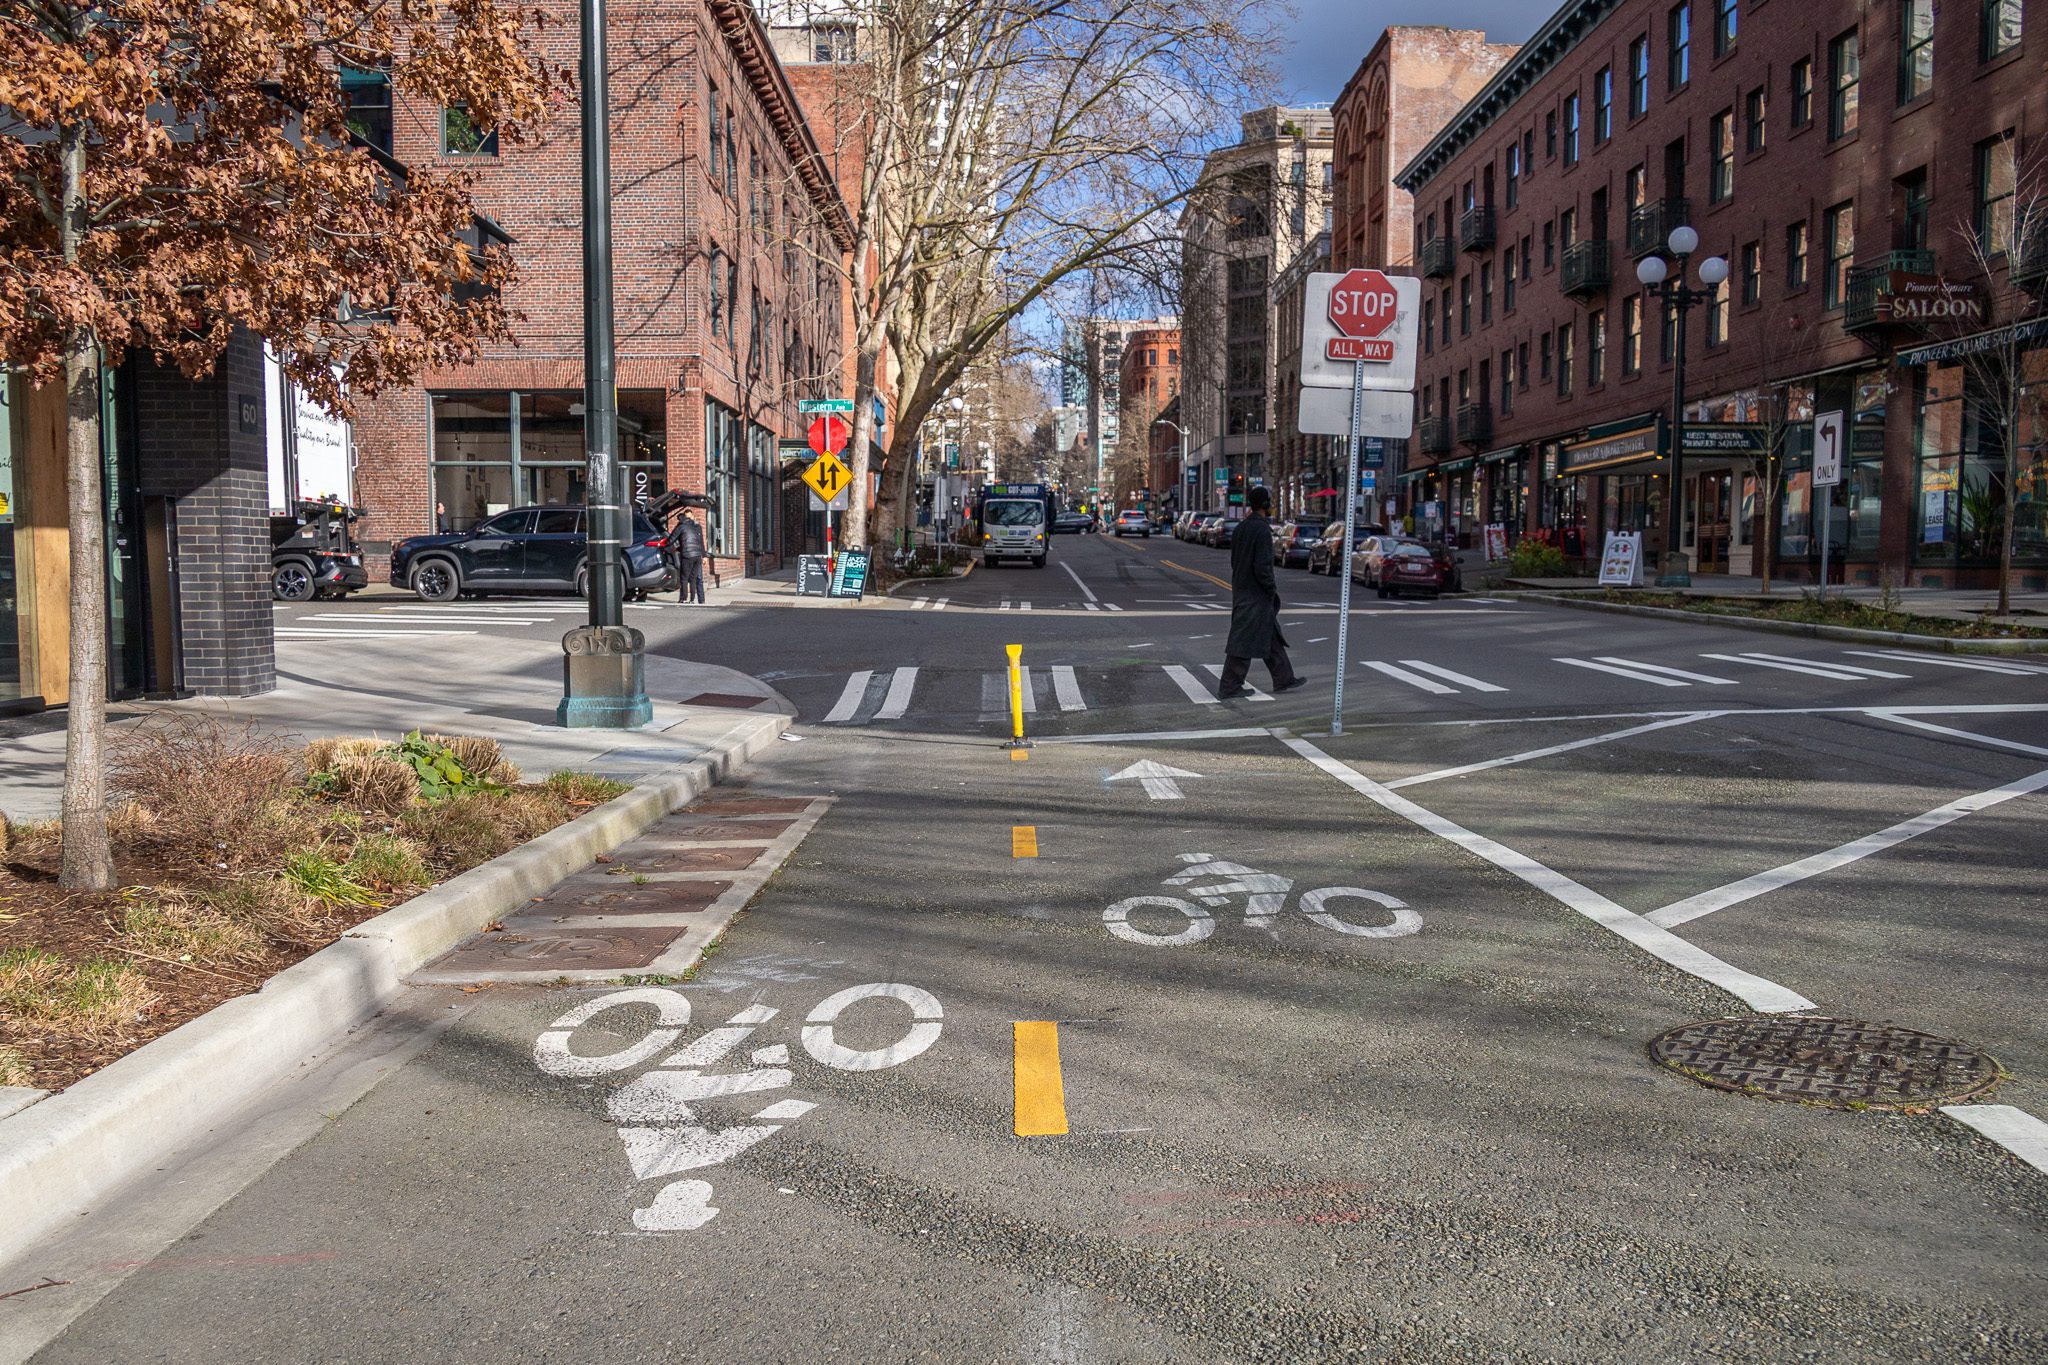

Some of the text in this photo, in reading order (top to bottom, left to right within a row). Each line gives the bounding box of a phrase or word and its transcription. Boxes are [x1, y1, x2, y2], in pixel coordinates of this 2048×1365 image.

[1905, 281, 1973, 294] Pioneer Square
[1333, 290, 1395, 317] STOP
[1893, 297, 1982, 318] SALOON
[1333, 342, 1390, 357] ALL WAY
[1910, 324, 2035, 366] PIONEER SQUARE SALOON
[243, 404, 256, 423] 60
[801, 402, 832, 411] Western
[1817, 464, 1836, 480] ONLY
[1926, 515, 1944, 525] LEASE
